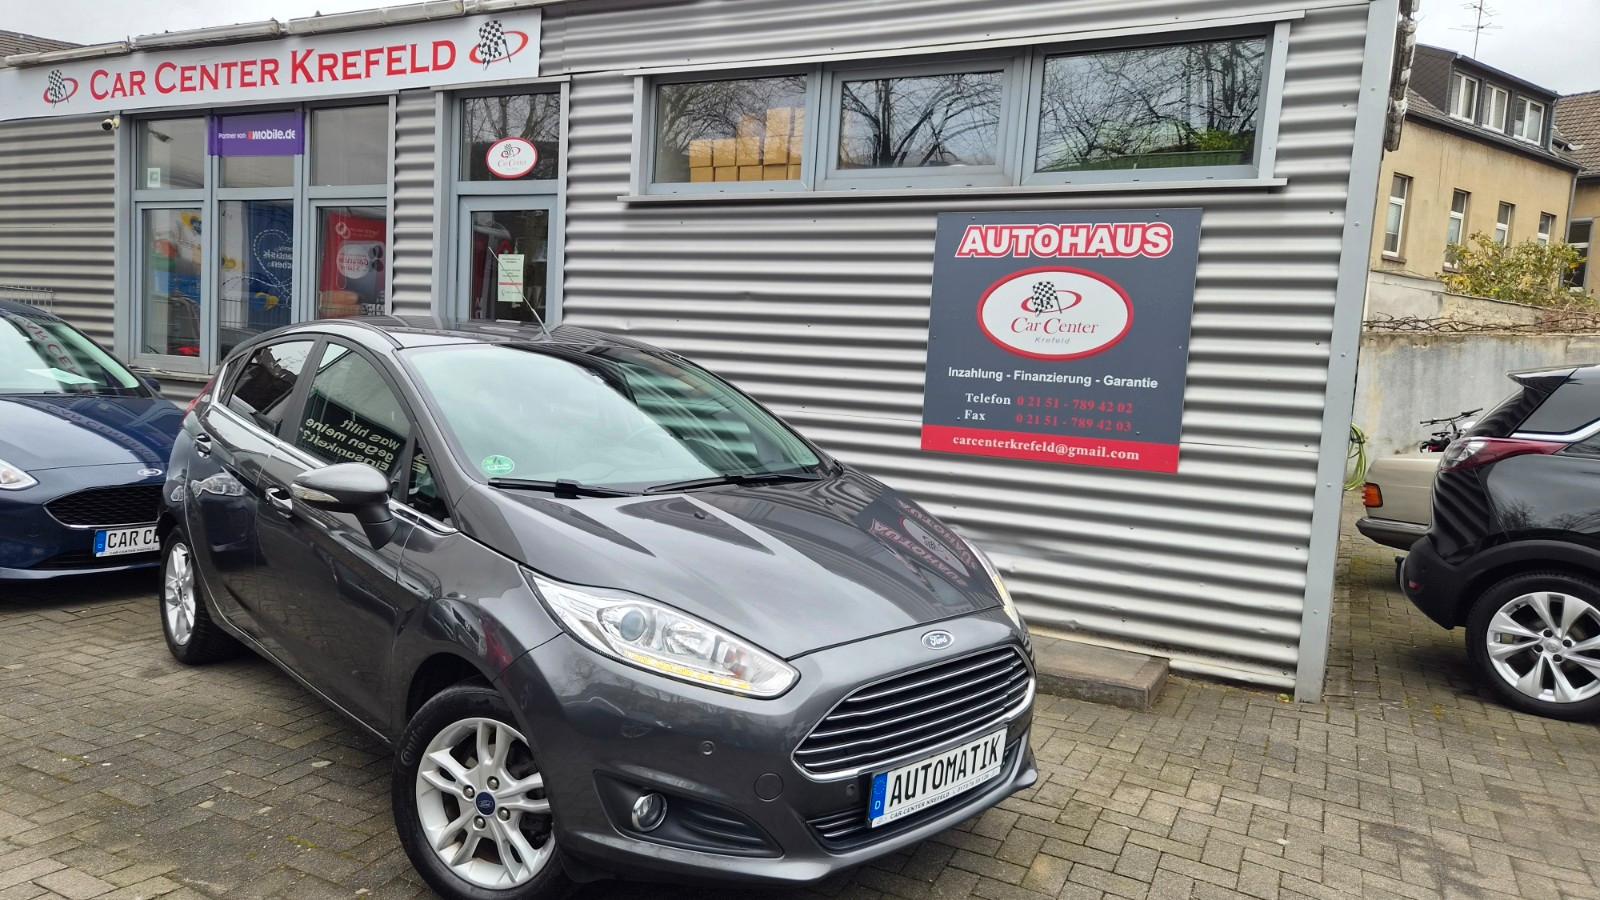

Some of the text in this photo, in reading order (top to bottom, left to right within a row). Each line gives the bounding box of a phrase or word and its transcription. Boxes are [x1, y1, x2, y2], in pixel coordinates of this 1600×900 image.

[90, 40, 457, 100] CAR CENTER KREFELD
[954, 222, 1173, 259] AUTOHAUS
[1010, 316, 1099, 335] Car Center
[1034, 336, 1070, 345] Krefeld
[948, 366, 1003, 382] Inzahlung
[1013, 370, 1092, 387] Finanzierung
[1103, 375, 1159, 389] Garantie
[965, 393, 1011, 405] Telefon
[1016, 395, 1025, 407] 0
[1072, 399, 1095, 410] 789
[1098, 400, 1114, 413] 42
[1117, 401, 1134, 415] 02
[964, 409, 986, 421] Fax
[1015, 414, 1024, 424] 0
[1071, 417, 1094, 429] 789
[1097, 419, 1113, 432] 42
[1115, 420, 1132, 433] 03
[952, 436, 1140, 460] carcenterkrefeld@gmail.com
[108, 531, 139, 548] CAR
[874, 800, 881, 810] D
[889, 734, 1001, 807] AUTOMATIK
